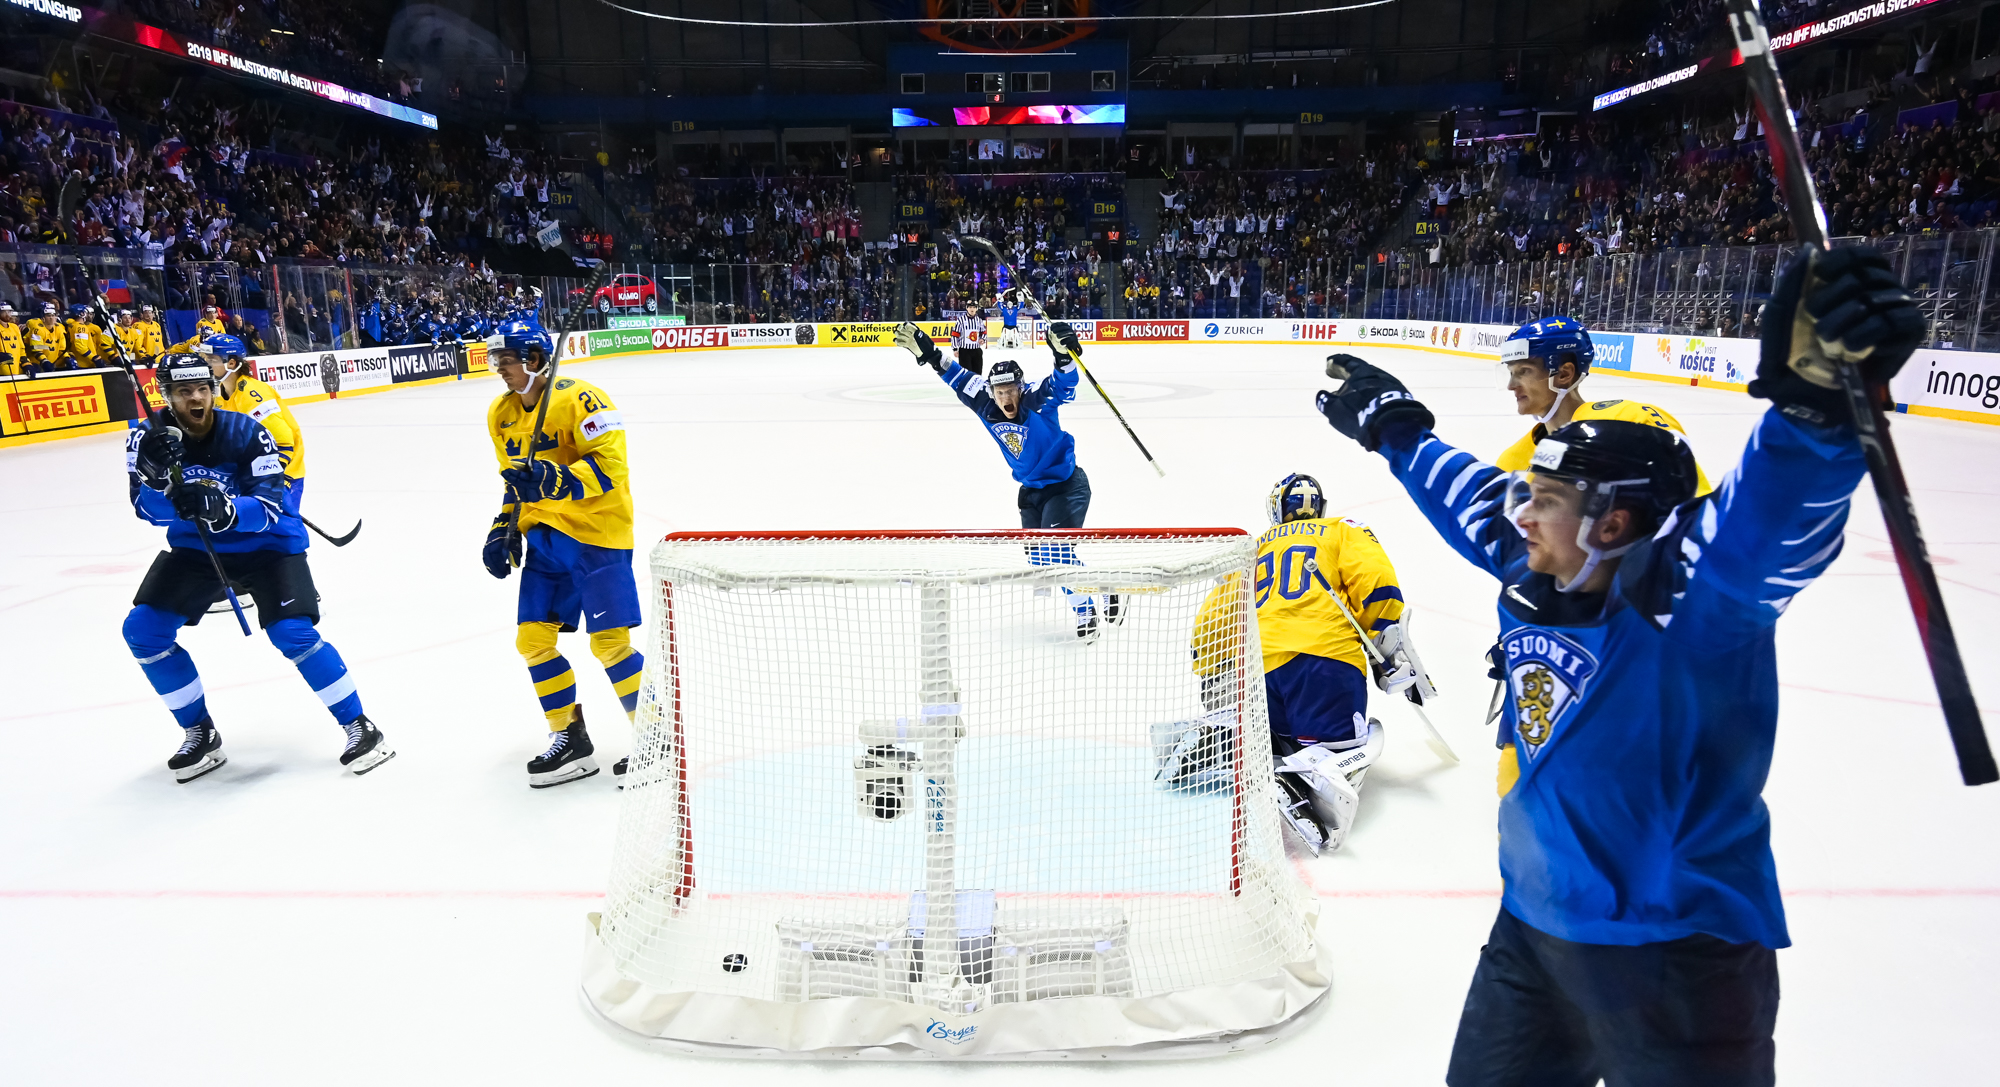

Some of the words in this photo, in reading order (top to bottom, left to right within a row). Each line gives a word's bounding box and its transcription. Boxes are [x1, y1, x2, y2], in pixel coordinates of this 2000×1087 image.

[1770, 32, 1792, 51] 2019
[1793, 26, 1810, 44] IIHF
[187, 42, 212, 59] 2019
[213, 49, 228, 65] IIHF
[230, 55, 290, 84] MAJSTROVSTVÁ
[290, 73, 312, 91] SVETA
[312, 81, 318, 93] V
[1610, 89, 1631, 103] HOCKEY
[1630, 81, 1651, 99] WORLD
[1651, 64, 1698, 90] CHAMPIONSHIP
[1301, 113, 1311, 123] A
[1312, 113, 1323, 123] 19
[673, 121, 682, 132] B
[683, 121, 695, 131] 18
[551, 192, 561, 204] B
[561, 194, 573, 204] 17
[903, 205, 913, 216] B
[913, 206, 924, 215] 19
[1095, 203, 1105, 214] B
[1105, 204, 1116, 213] 19
[1416, 222, 1427, 234] A
[619, 318, 647, 328] ŠKODA
[658, 317, 686, 326] ŠKODA
[747, 327, 792, 337] TISSOT
[850, 324, 897, 333] Raiffeisen
[1122, 322, 1186, 339] KRUŠOVICE
[1224, 326, 1264, 335] ZURICH
[1302, 324, 1337, 339] IIHF
[1370, 326, 1398, 337] ŠKODA
[1409, 327, 1425, 339] ŠKODA
[596, 336, 614, 349] ŠKODA
[622, 334, 650, 346] ŠKODA
[652, 327, 728, 348] ФОНБЕТ
[851, 334, 880, 343] BANK
[1704, 346, 1717, 354] VISIT
[354, 356, 387, 372] TISSOT
[391, 352, 429, 376] NIVEA
[429, 350, 456, 371] MEN
[1679, 353, 1716, 372] KOŠICE
[276, 363, 317, 381] TISSOT
[277, 382, 298, 391] WATCHES
[298, 380, 311, 388] SINCE
[1926, 361, 2000, 409] innog
[250, 390, 263, 403] 9
[578, 390, 608, 413] 21
[6, 385, 98, 423] PIRELLI
[994, 425, 1023, 433] SUOMI
[1507, 635, 1584, 677] SUOMI
[1336, 752, 1366, 768] BAUER
[926, 1017, 978, 1041] Berger
